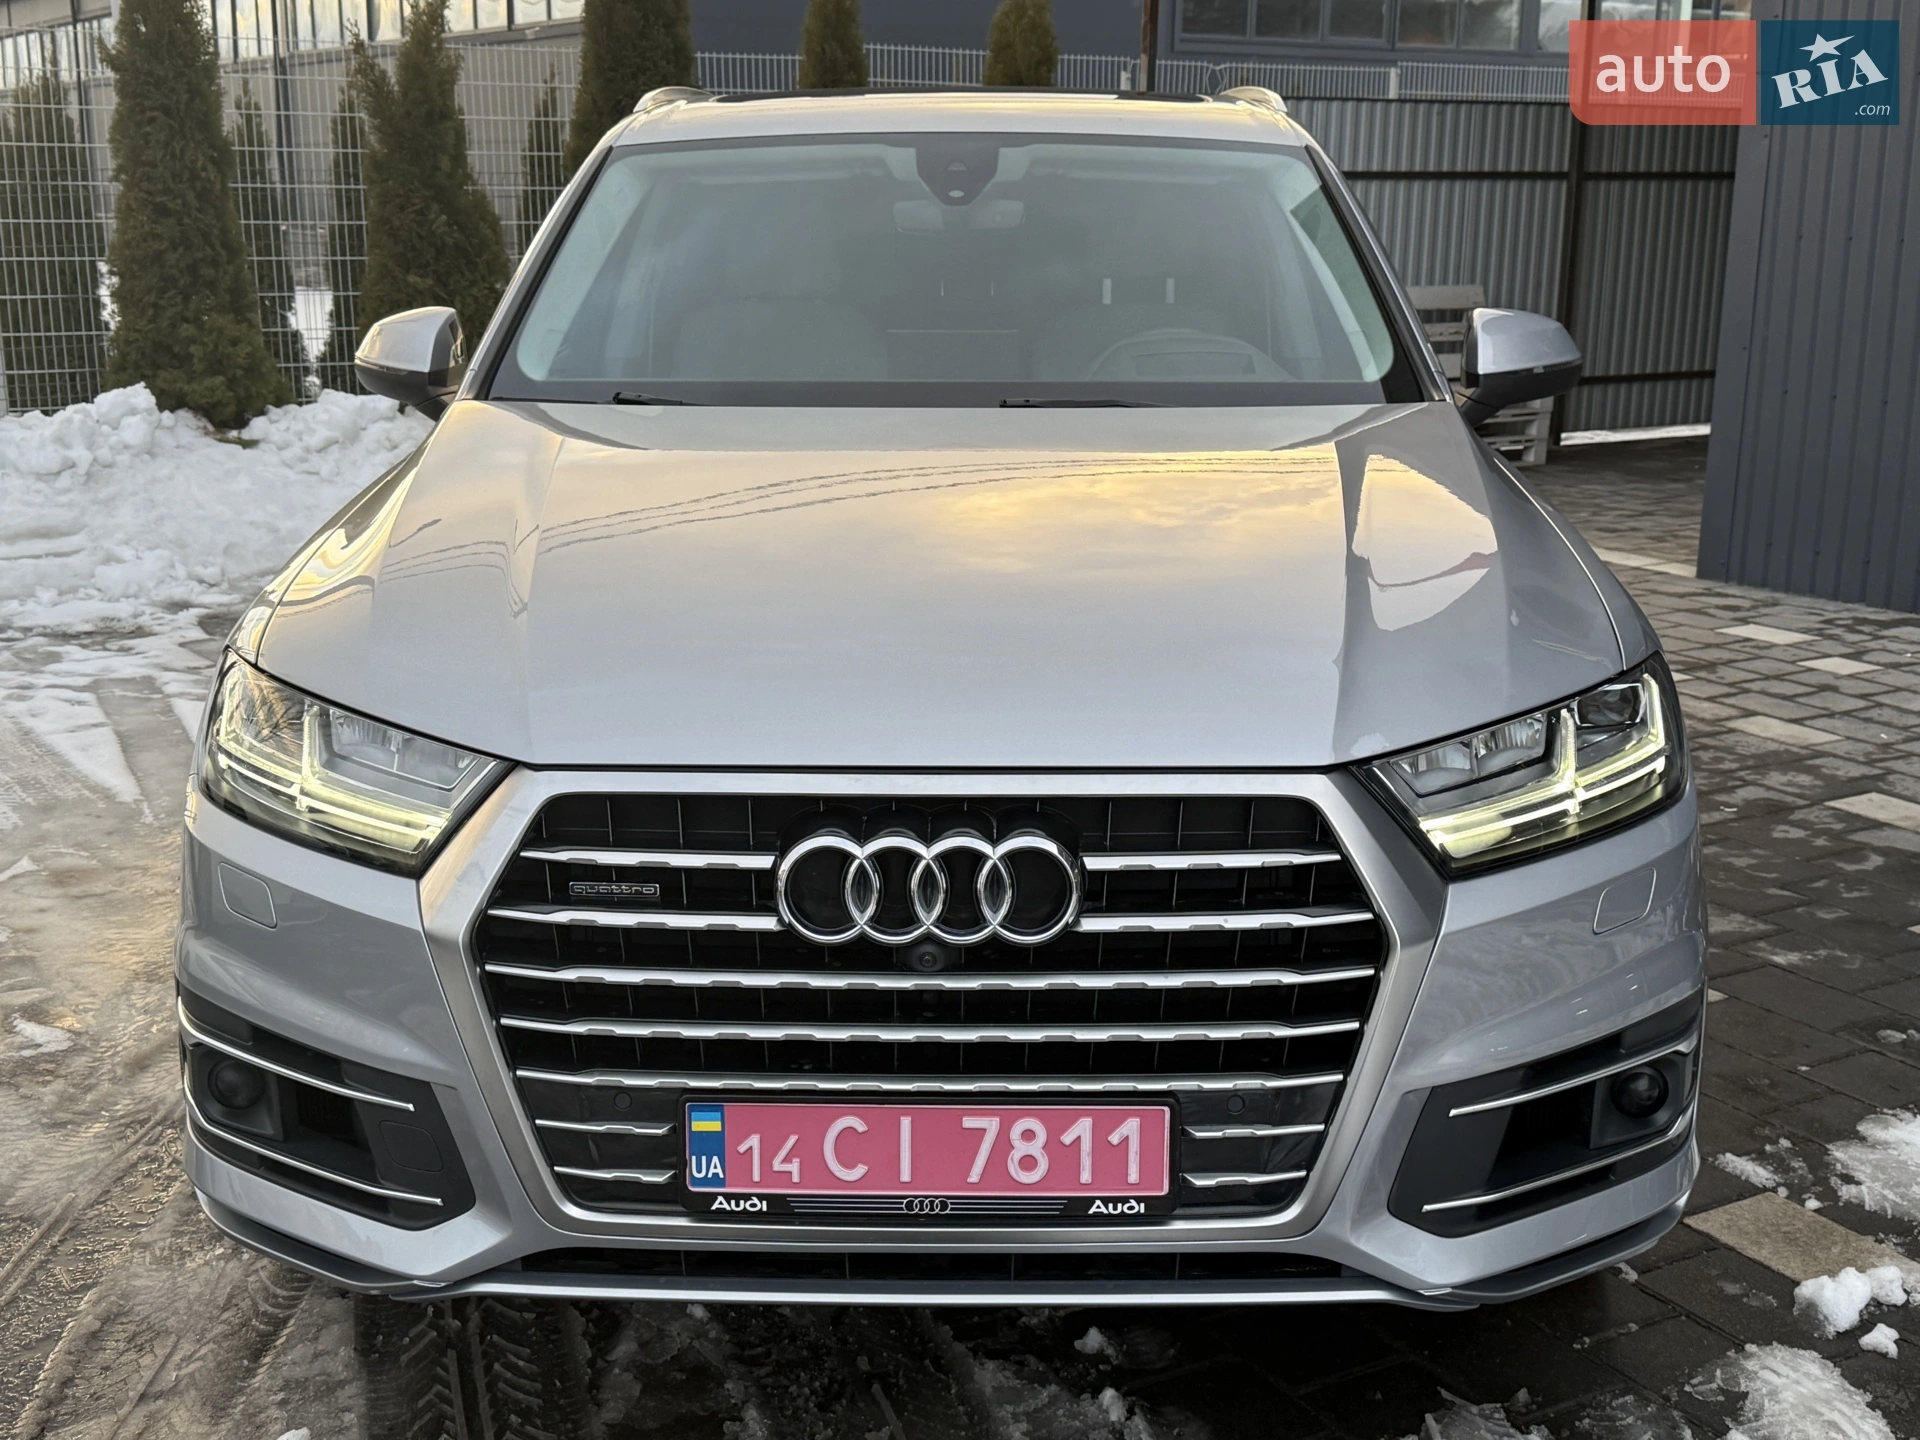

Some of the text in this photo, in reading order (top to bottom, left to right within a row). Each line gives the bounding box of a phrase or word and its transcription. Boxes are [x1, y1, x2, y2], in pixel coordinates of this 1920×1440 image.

[573, 885, 655, 894] quattro
[736, 1133, 800, 1183] 14
[961, 1117, 1141, 1184] 7811
[691, 1155, 724, 1178] UA
[710, 1196, 768, 1212] Audi
[1087, 1199, 1146, 1214] Audi
